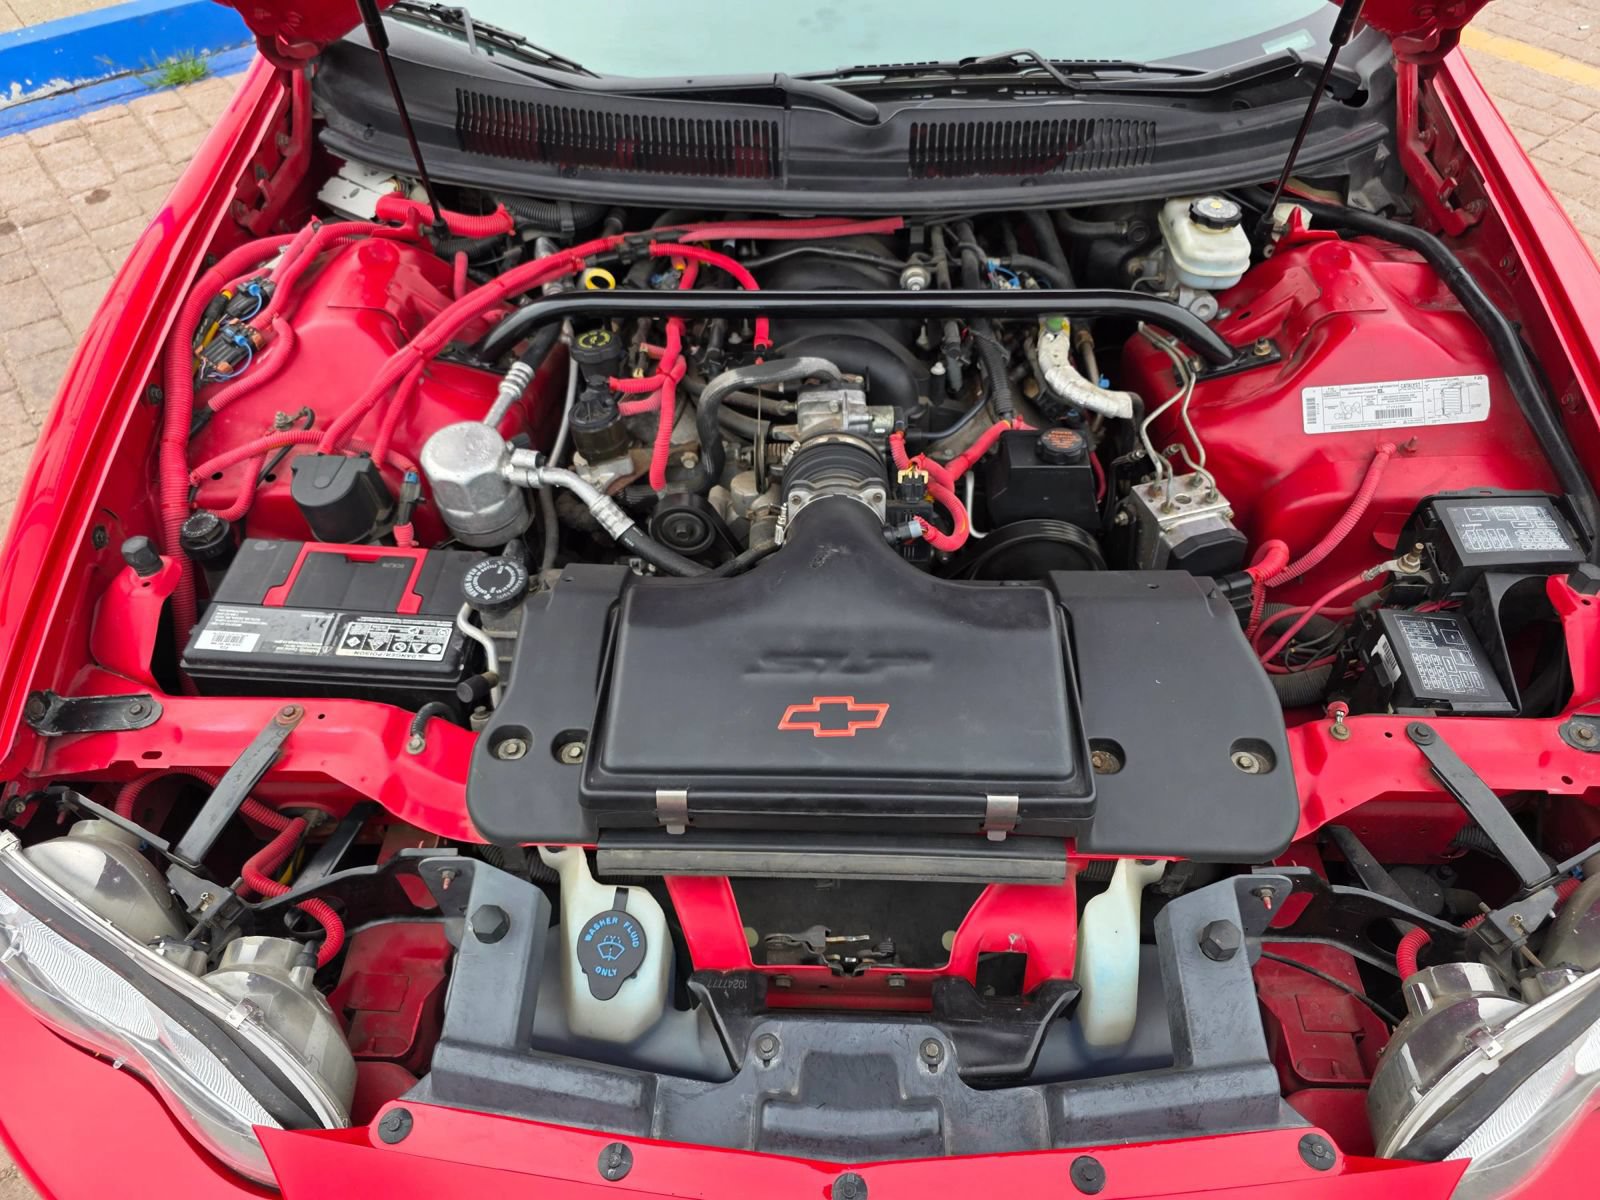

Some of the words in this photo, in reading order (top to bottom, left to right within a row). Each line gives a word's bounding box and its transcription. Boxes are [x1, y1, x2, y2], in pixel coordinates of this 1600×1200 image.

[464, 568, 479, 582] OPEN
[585, 917, 618, 942] WASHER
[624, 922, 641, 947] FLUID
[594, 966, 618, 977] ONLY
